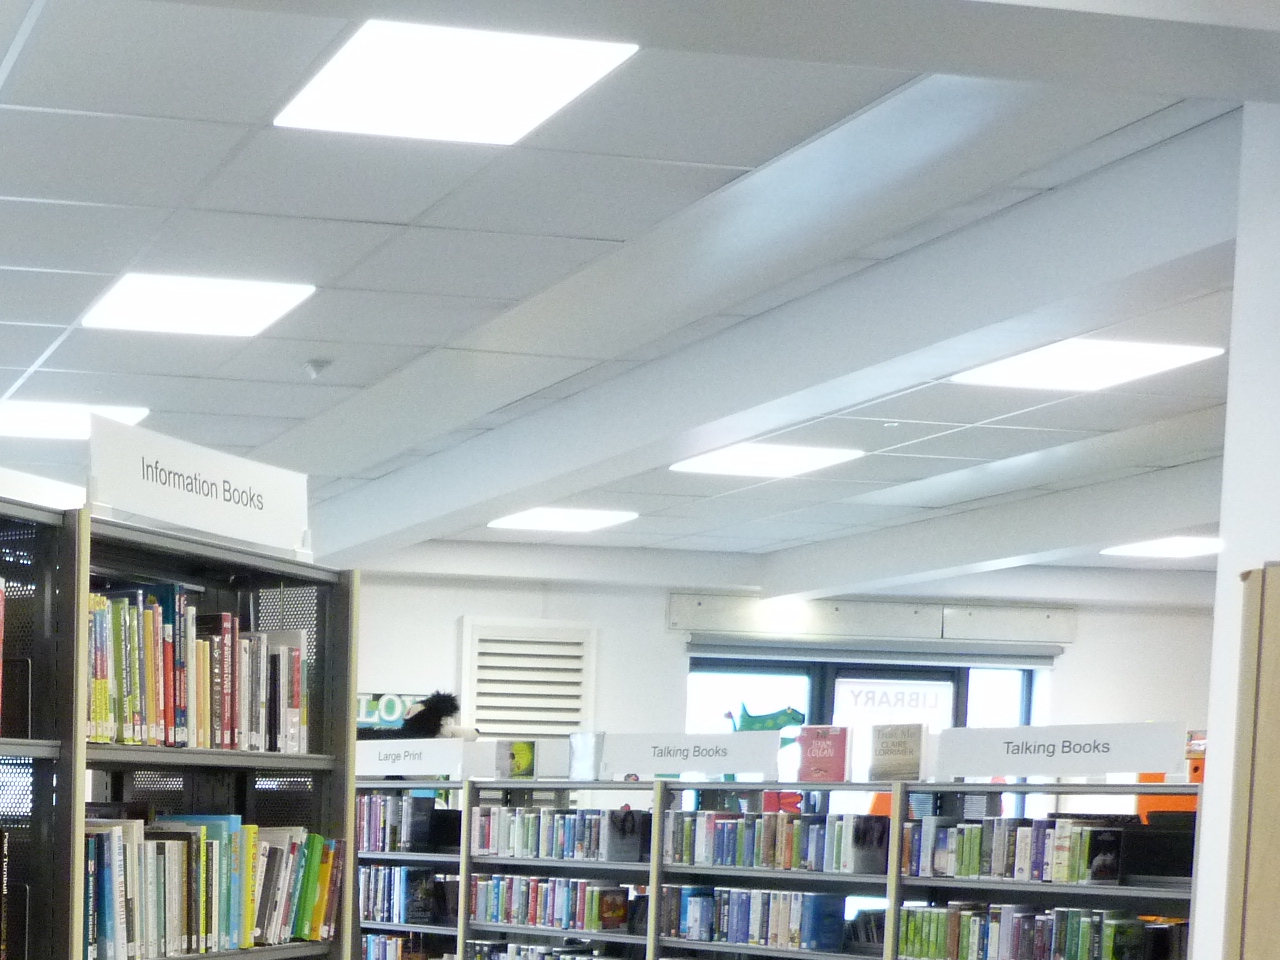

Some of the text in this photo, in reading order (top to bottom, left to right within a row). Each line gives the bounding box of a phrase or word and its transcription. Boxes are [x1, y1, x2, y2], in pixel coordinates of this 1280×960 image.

[141, 457, 264, 510] Information Books
[652, 746, 727, 760] Talking Books
[1004, 740, 1110, 757] Talking Books
[379, 751, 422, 763] Large Print
